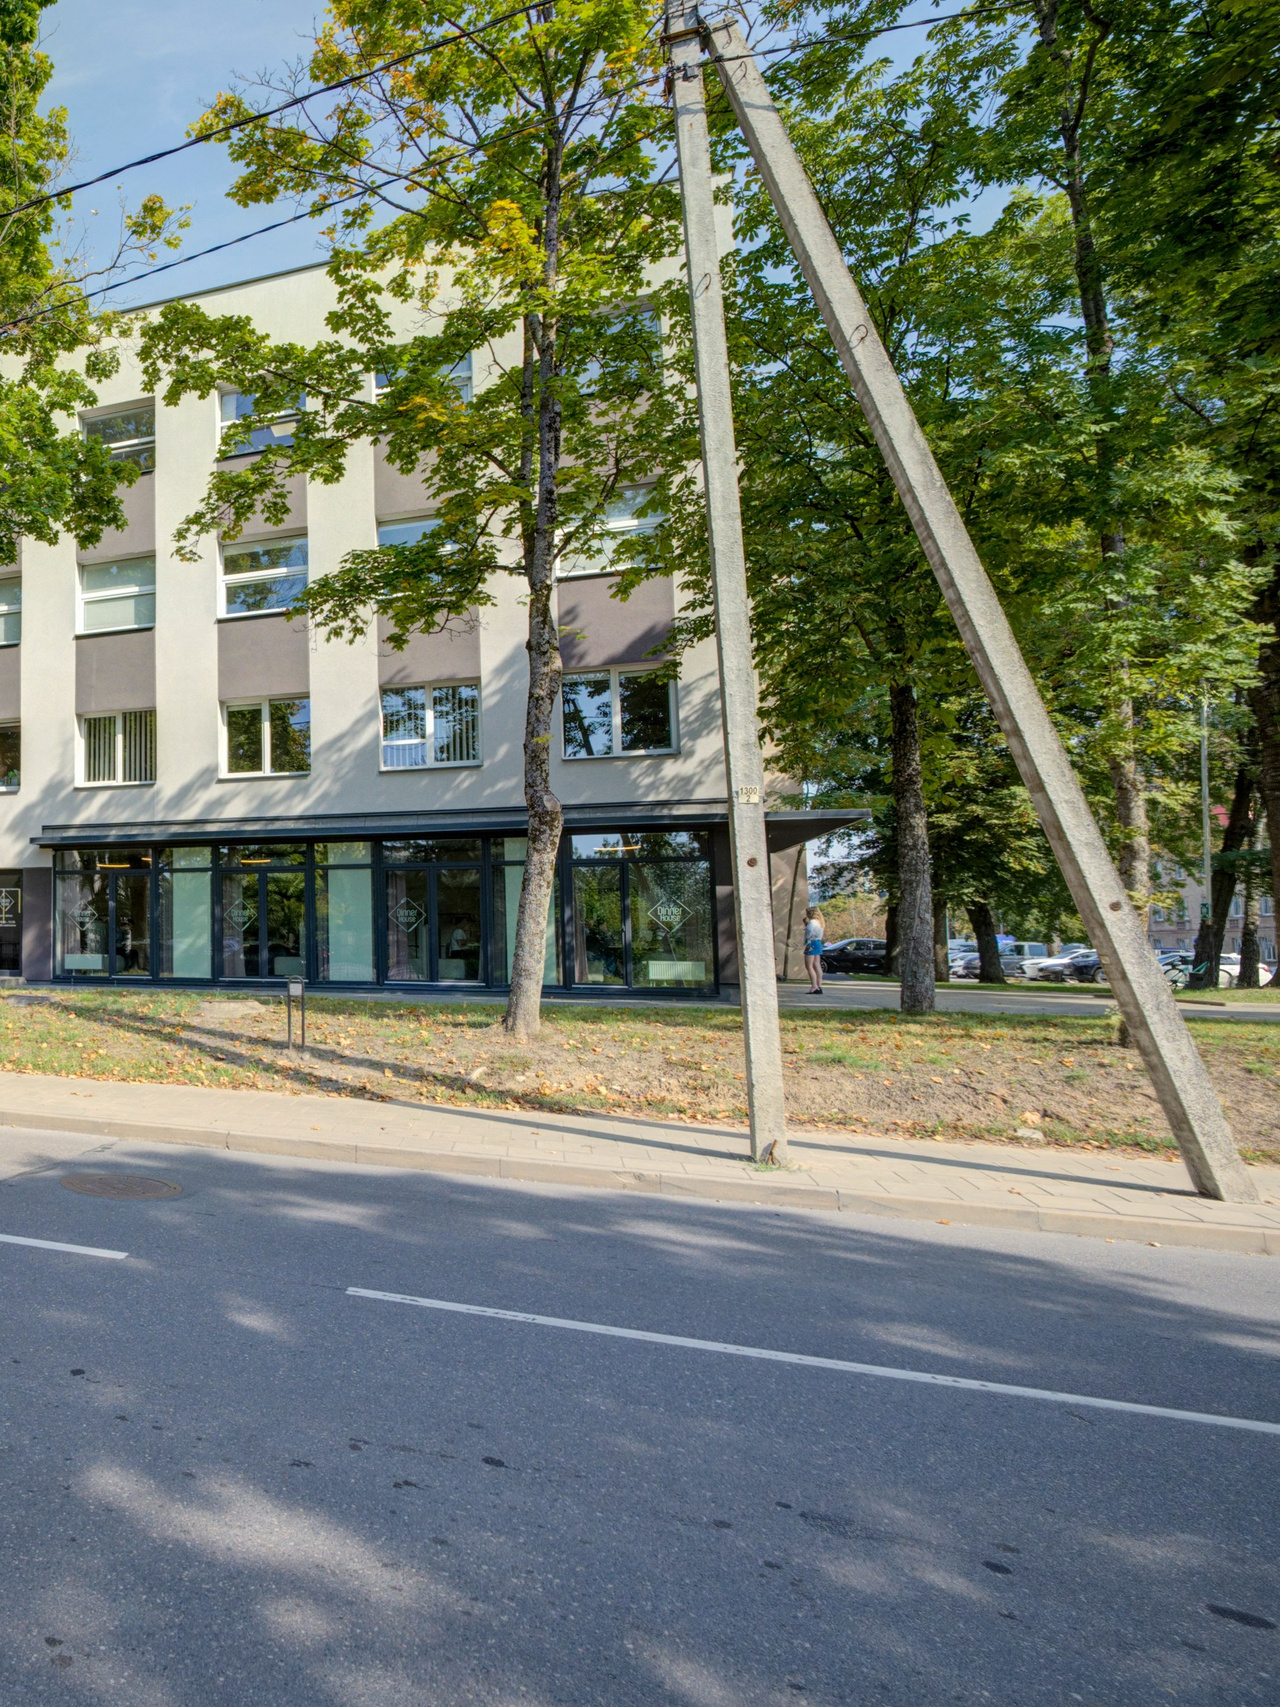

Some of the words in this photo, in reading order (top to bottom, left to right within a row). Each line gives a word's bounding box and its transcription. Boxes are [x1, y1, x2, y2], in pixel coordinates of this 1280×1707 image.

[740, 787, 758, 795] 1300
[397, 908, 417, 917] Dinner
[657, 906, 682, 915] Dinner
